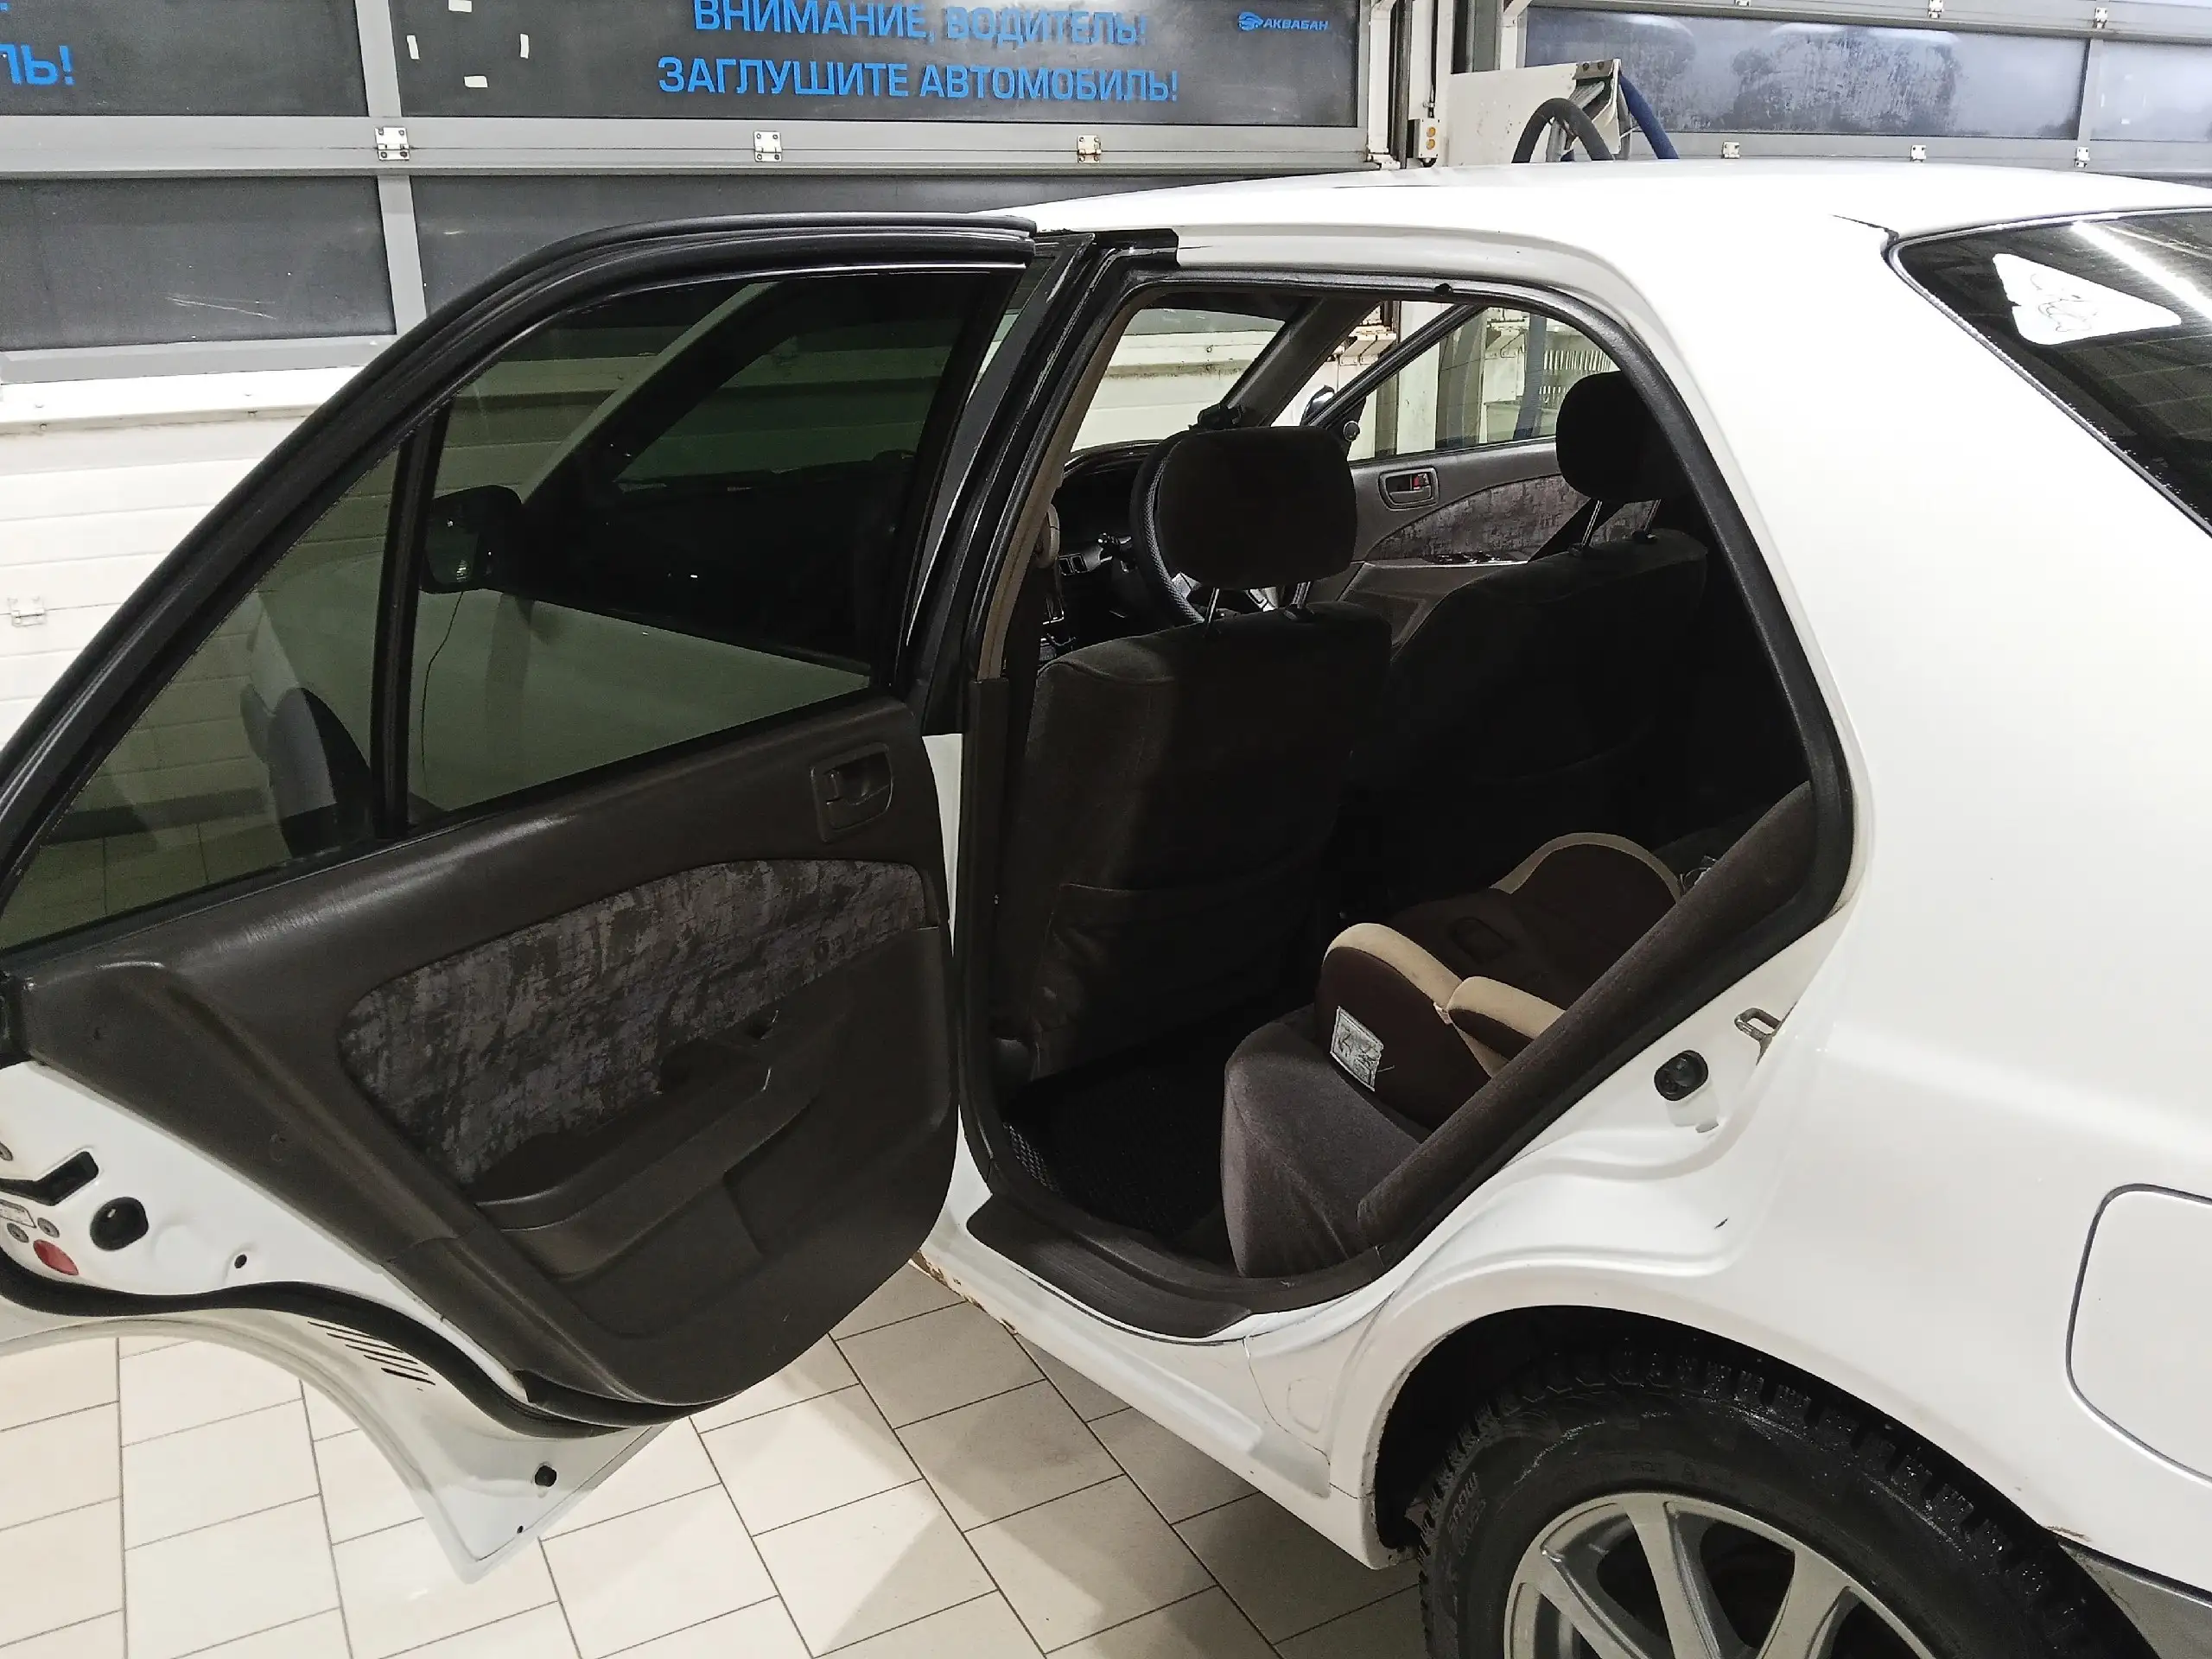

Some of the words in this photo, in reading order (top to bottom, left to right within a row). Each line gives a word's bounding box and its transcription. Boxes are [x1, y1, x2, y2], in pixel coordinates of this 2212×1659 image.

[693, 0, 936, 43] ВНИМАНИЕ,
[947, 6, 1147, 49] ВОДИТЕЛЬ!
[1263, 17, 1329, 31] АКВАБАН
[658, 56, 909, 96] ЗАГЛУШИТЕ
[920, 64, 1179, 101] АВТОМОБИЛЬ!
